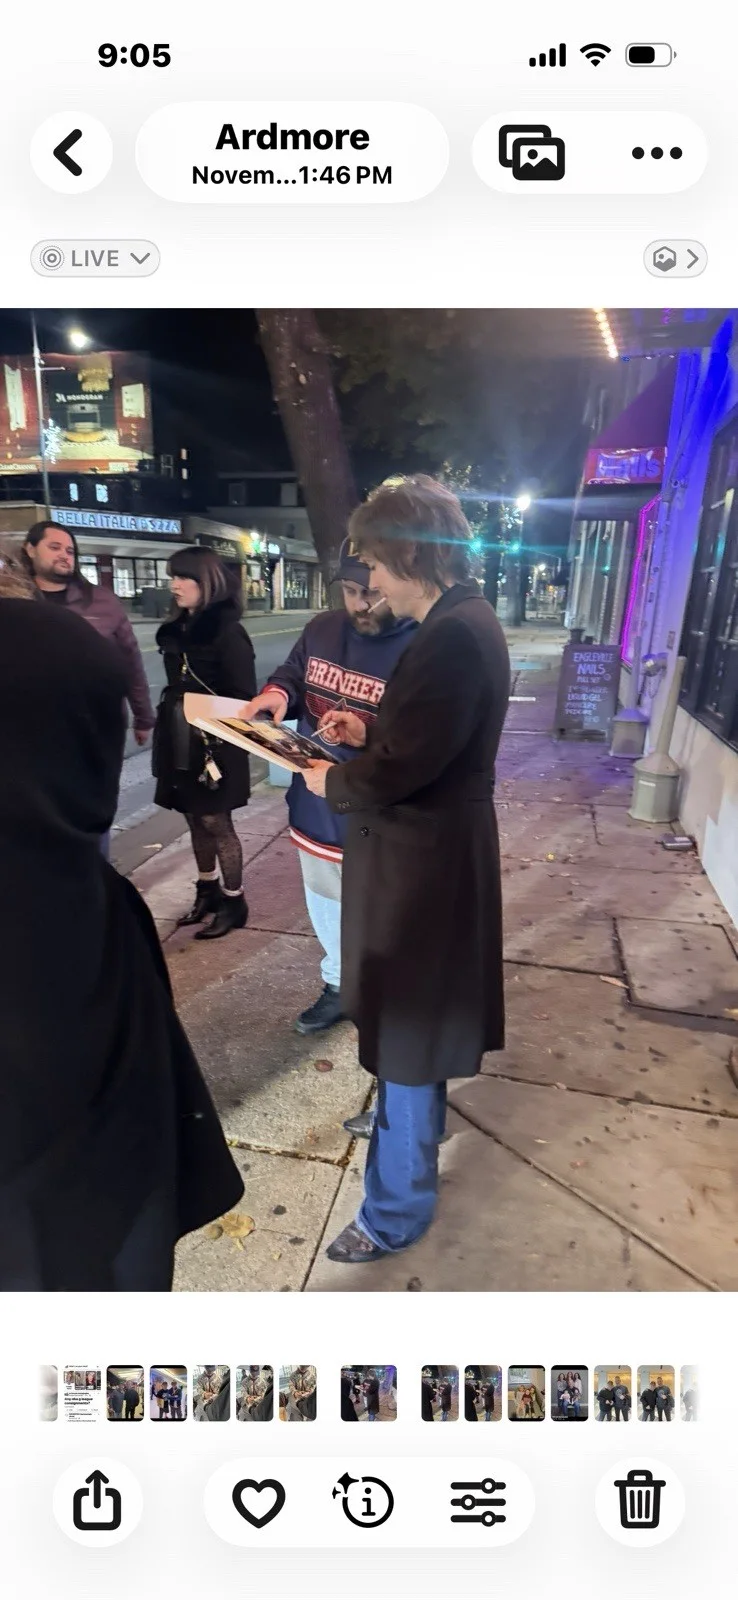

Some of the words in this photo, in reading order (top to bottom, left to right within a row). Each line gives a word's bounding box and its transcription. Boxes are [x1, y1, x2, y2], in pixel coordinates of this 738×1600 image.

[56, 511, 95, 526] BELLA
[99, 515, 137, 529] ITALIA
[577, 663, 606, 675] NAILS
